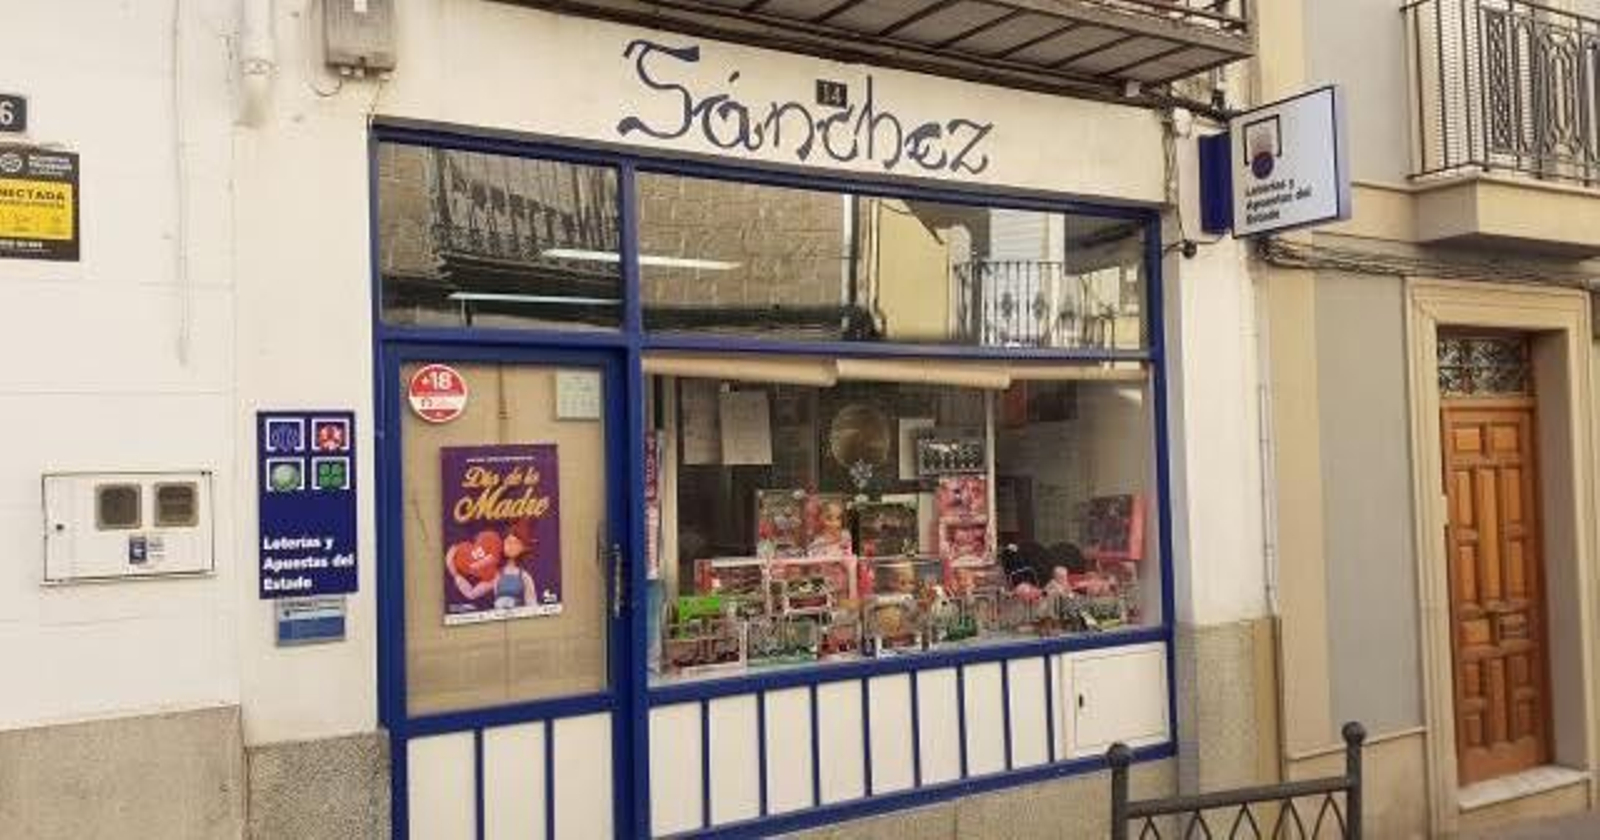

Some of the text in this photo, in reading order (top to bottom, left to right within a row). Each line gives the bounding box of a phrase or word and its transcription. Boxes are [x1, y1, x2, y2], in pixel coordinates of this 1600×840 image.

[823, 83, 841, 104] 14
[616, 39, 994, 175] Sánchez
[453, 486, 551, 522] Madre
[262, 554, 355, 574] Apuestas del
[263, 575, 313, 591] Estado
